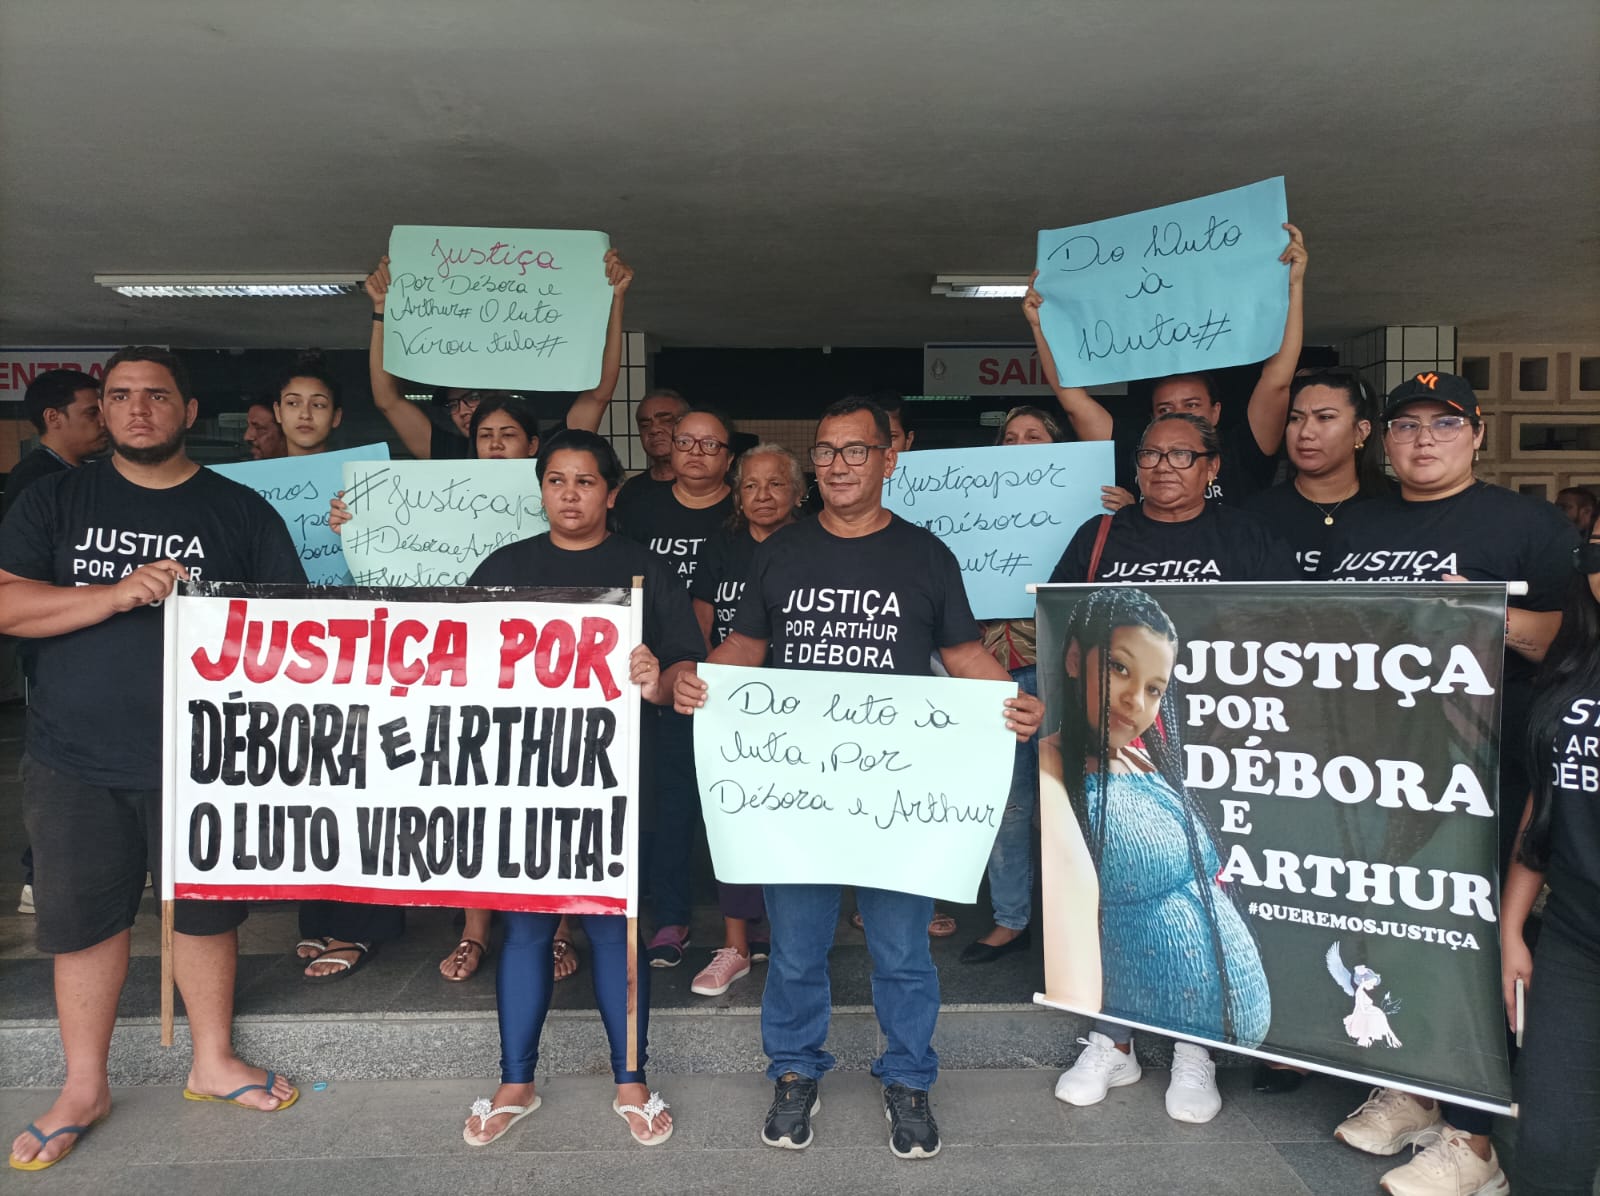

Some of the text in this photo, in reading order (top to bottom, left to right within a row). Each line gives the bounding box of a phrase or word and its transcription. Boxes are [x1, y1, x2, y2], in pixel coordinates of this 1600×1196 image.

[431, 238, 562, 279] Justiça
[442, 274, 529, 296] Débora
[504, 302, 562, 324] luto
[75, 527, 205, 560] JUSTIÇA
[73, 558, 115, 578] POR
[1102, 559, 1222, 578] JUSTIÇA
[1332, 550, 1458, 576] JUSTIÇA
[782, 588, 901, 620] JUSTIÇA
[785, 620, 898, 643] POR ARTHUR
[498, 616, 622, 702] POR
[784, 640, 895, 670] E DÉBORA
[1173, 640, 1496, 708] JUSTIÇA
[822, 693, 899, 726] luto
[1185, 693, 1290, 732] POR
[188, 690, 619, 790] DÉBORA E ARTHUR
[1183, 735, 1495, 818] DÉBORA
[709, 779, 835, 815] Débora
[874, 789, 996, 830] Arthur
[1219, 799, 1253, 835] E
[188, 795, 628, 883] O LUTO VIROU LUTA!
[1218, 844, 1497, 923] ARTHUR
[1248, 901, 1480, 951] #QUEREMOSJUSTIÇA
